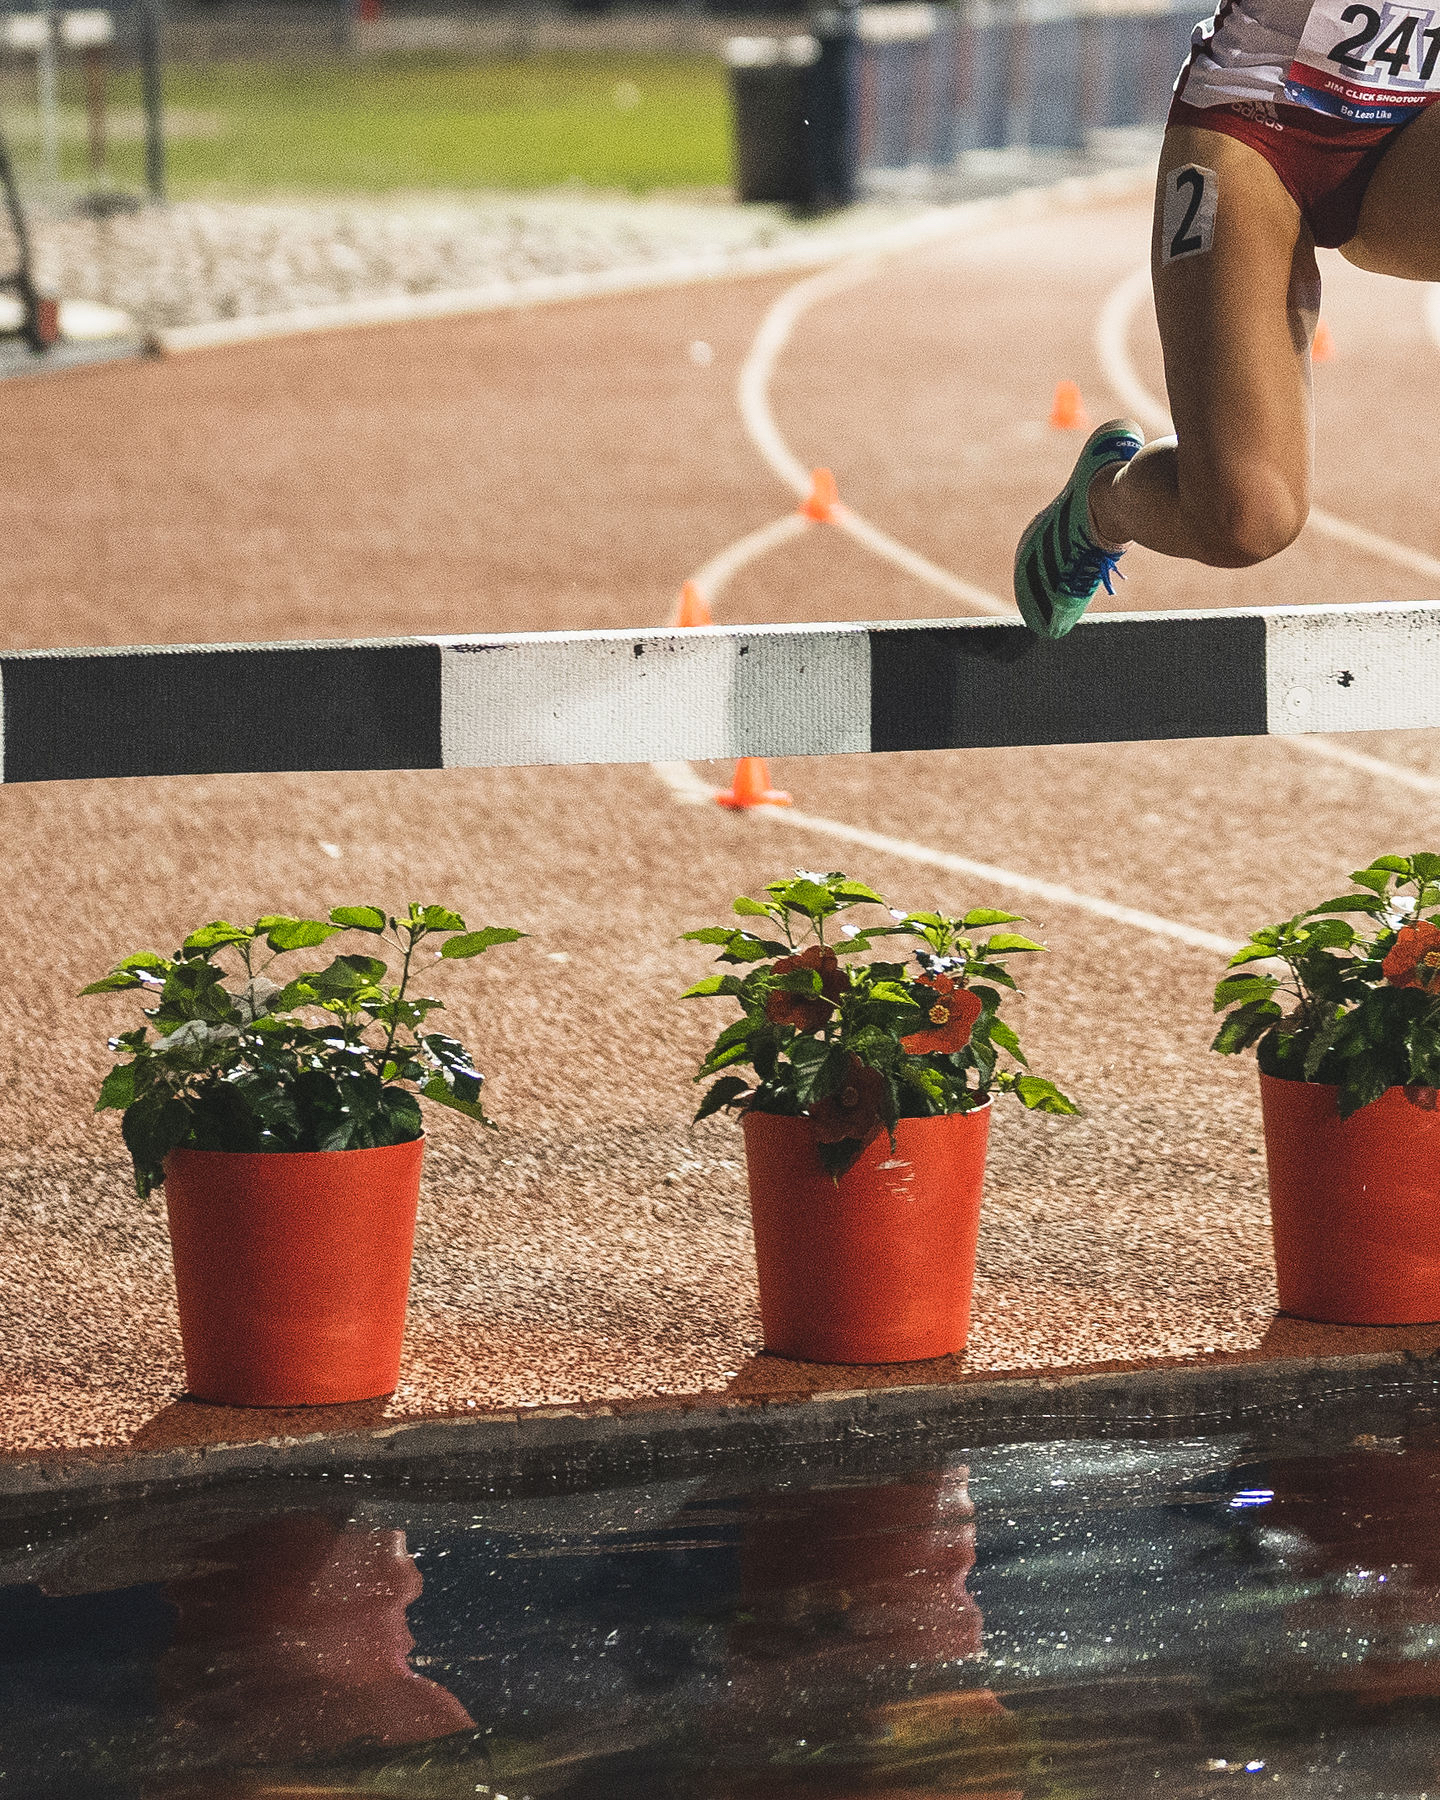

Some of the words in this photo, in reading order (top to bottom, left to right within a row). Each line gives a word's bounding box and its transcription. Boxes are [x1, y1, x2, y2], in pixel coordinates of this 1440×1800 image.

[1324, 80, 1344, 95] JIM
[1345, 89, 1376, 102] CLICK
[1376, 94, 1427, 104] SHOOTOUT
[1340, 105, 1354, 117] Be
[1375, 110, 1393, 119] Like
[1170, 168, 1205, 258] 2
